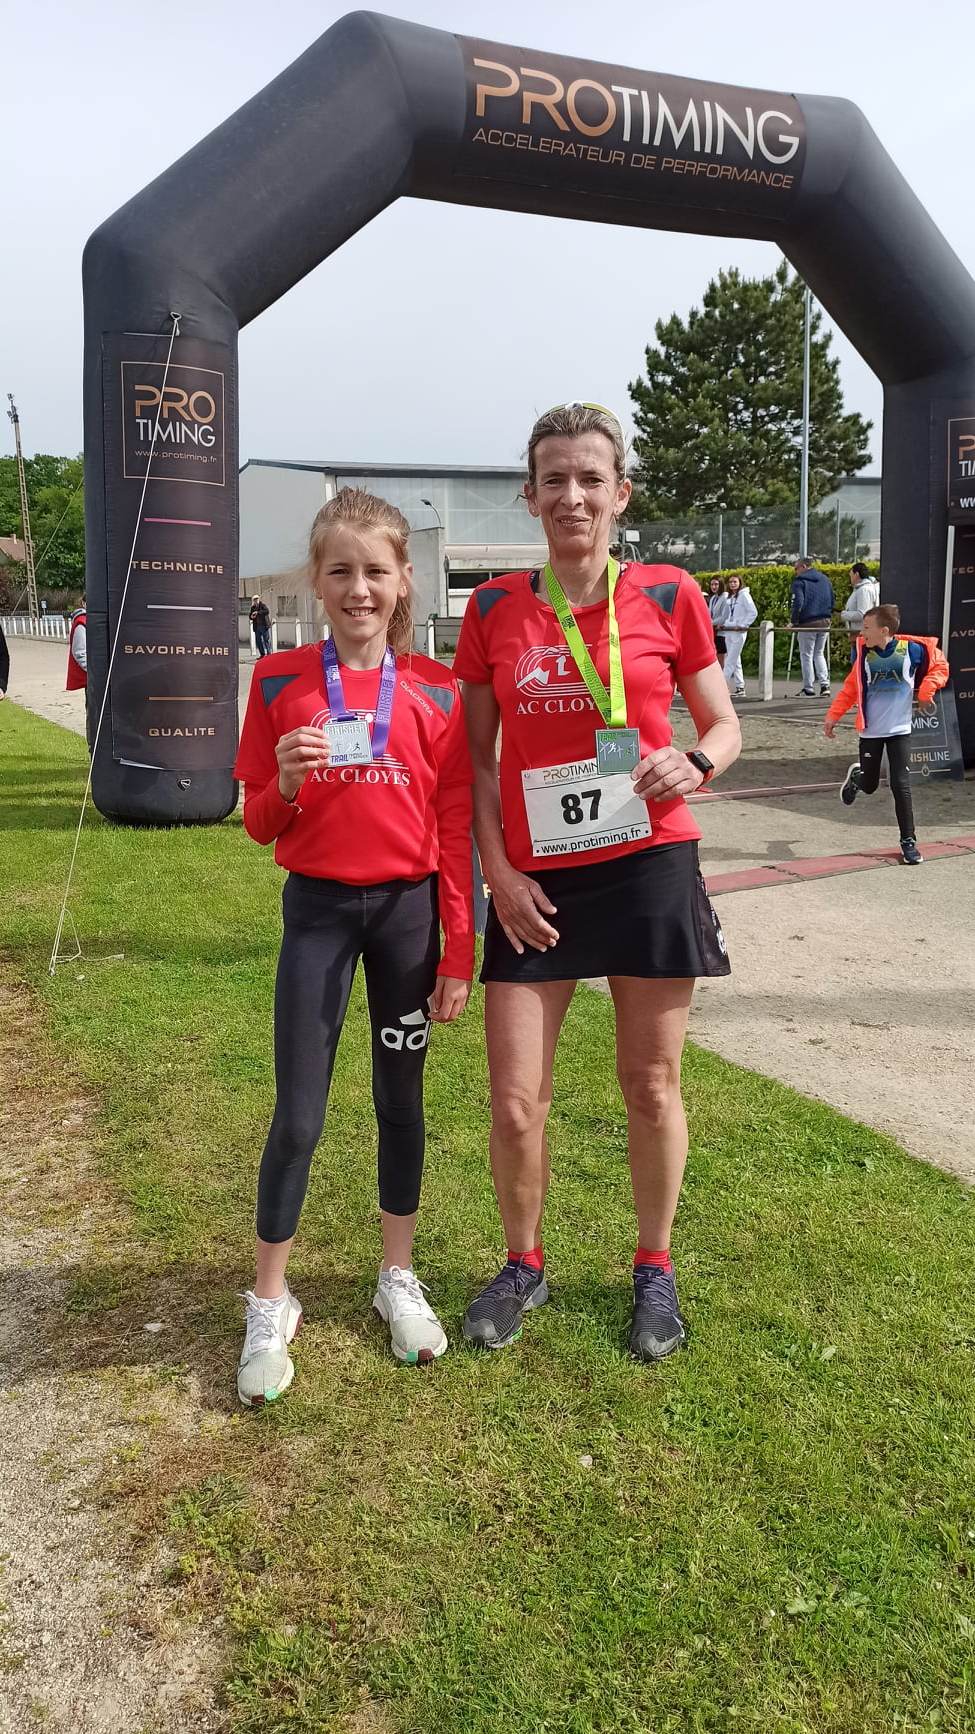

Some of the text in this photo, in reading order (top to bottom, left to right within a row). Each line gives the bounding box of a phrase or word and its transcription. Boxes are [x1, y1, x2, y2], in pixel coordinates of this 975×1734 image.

[473, 57, 800, 165] PROTIMING
[472, 127, 795, 189] ACCELERATEUR DE PERFORMANCE
[134, 384, 217, 424] PRO
[135, 418, 216, 448] TIMING
[134, 450, 217, 464] www.protiming.fr
[130, 560, 225, 575] TECHNICITE
[124, 645, 230, 657] SAVOIR-FAIRE
[399, 680, 434, 717] DIADORA
[516, 700, 544, 716] AC
[545, 697, 597, 715] CLOY
[148, 727, 217, 737] QUALITE
[910, 716, 940, 730] MING
[310, 768, 411, 787] AC CLOYES
[542, 761, 599, 783] PROTIMIN
[560, 788, 602, 825] 87
[540, 827, 643, 854] www.protiming.fr
